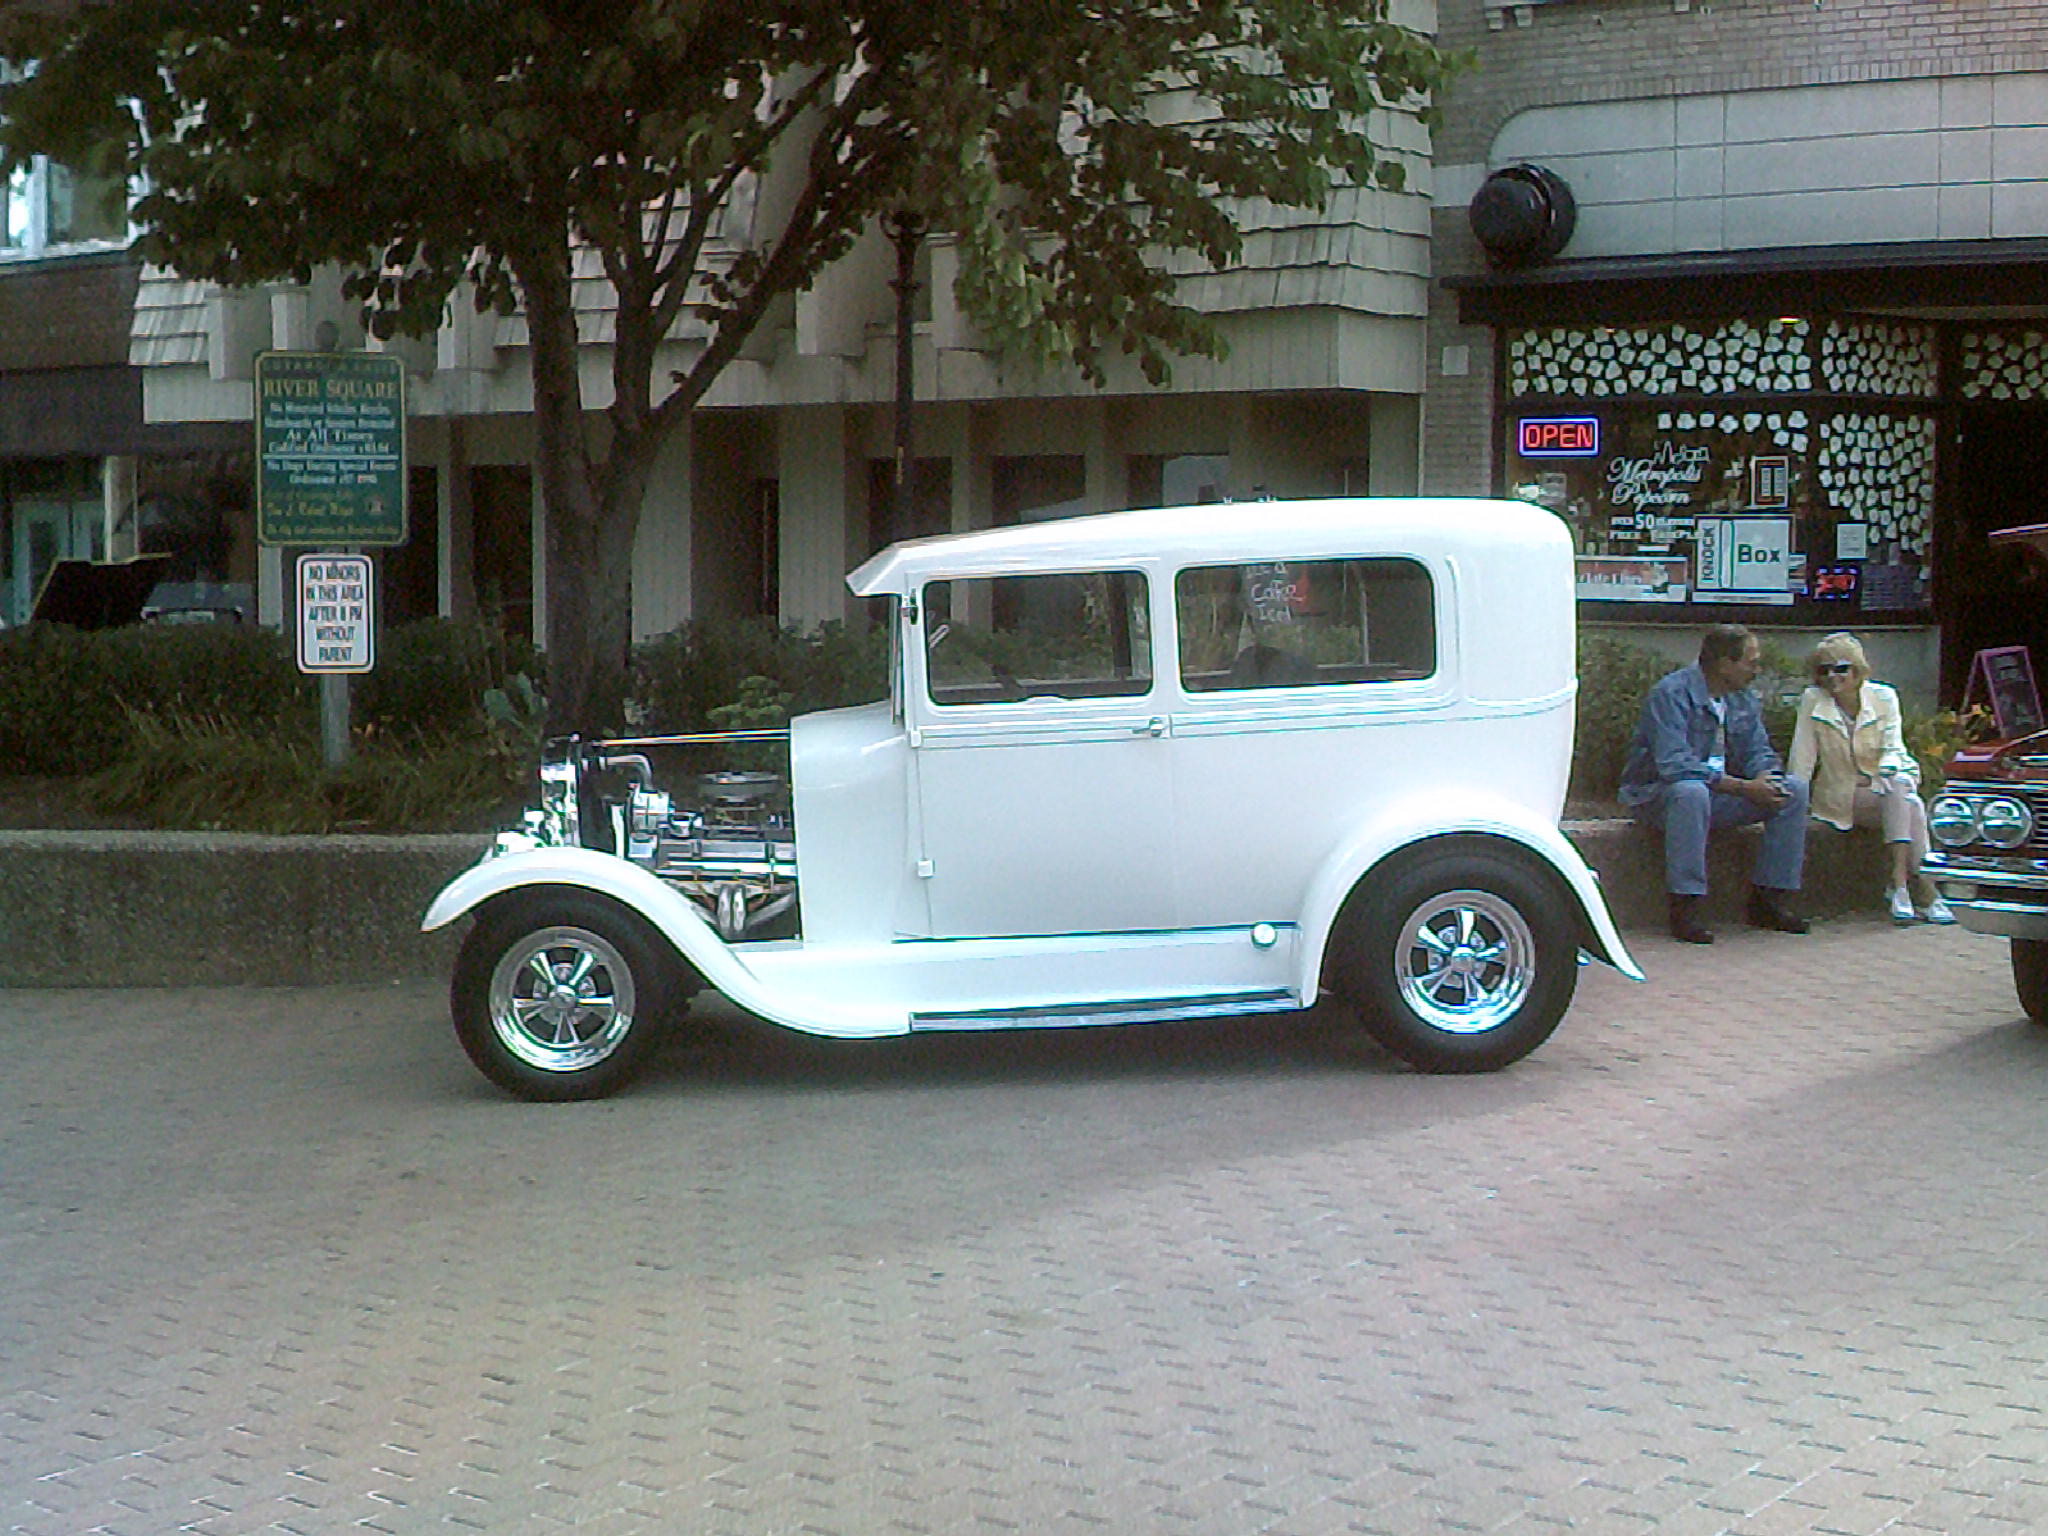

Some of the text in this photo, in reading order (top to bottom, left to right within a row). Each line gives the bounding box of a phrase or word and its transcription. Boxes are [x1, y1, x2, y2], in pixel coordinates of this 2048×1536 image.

[264, 378, 399, 400] RIVER SQUARE
[1525, 424, 1593, 448] OPEN
[1635, 513, 1655, 530] 50
[1738, 543, 1781, 563] Box
[308, 564, 324, 579] NO
[316, 626, 355, 641] WITHOUT
